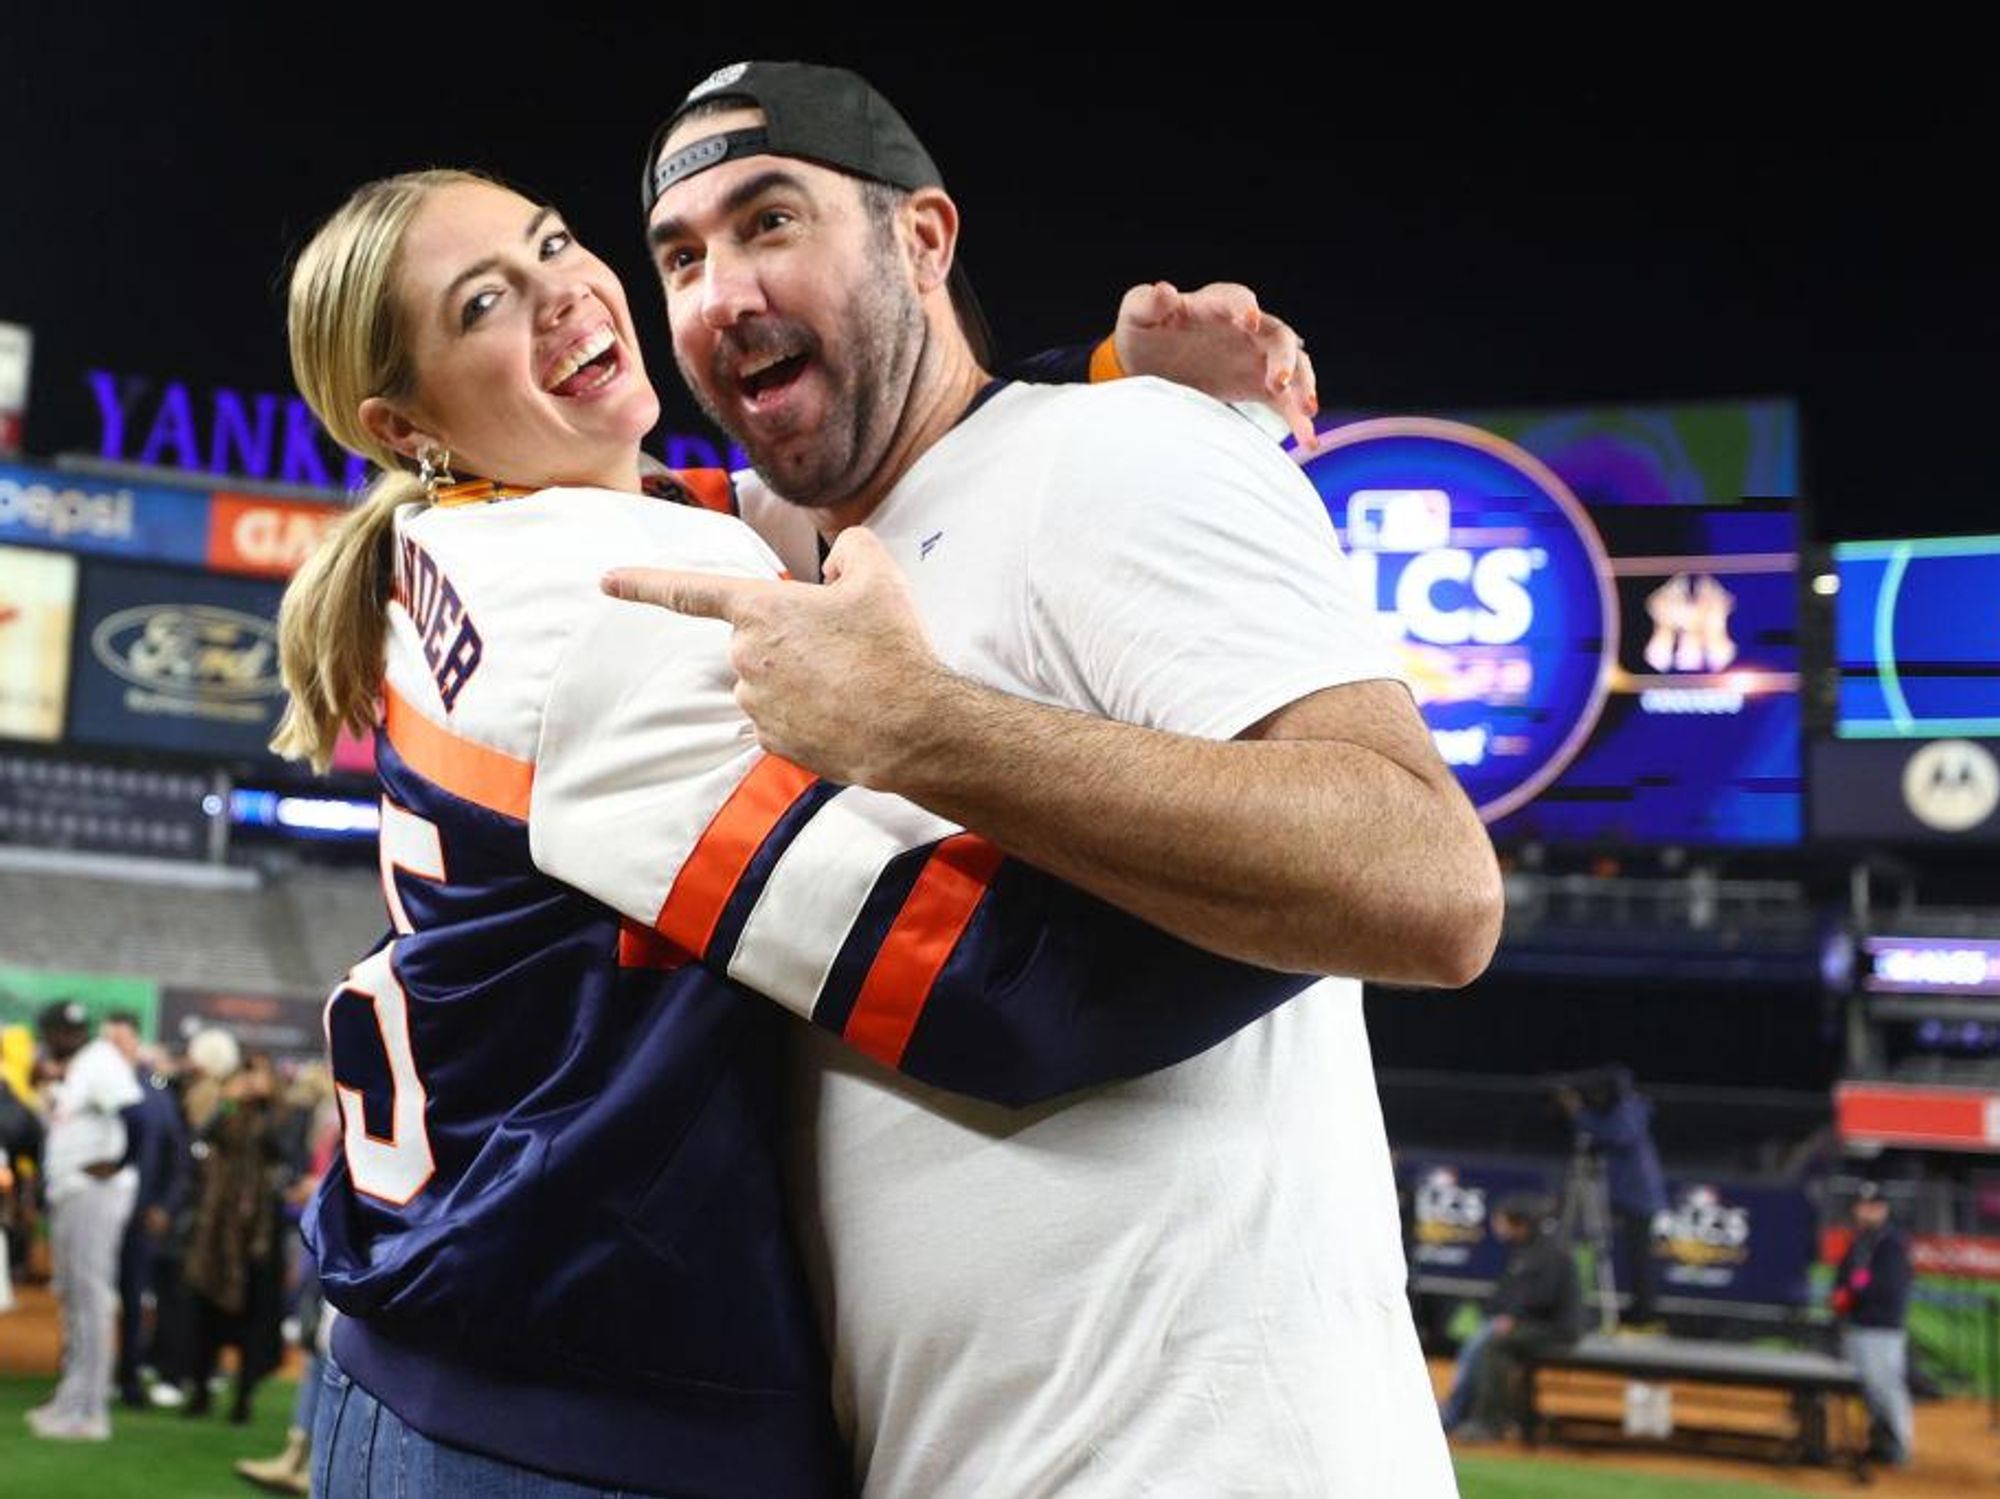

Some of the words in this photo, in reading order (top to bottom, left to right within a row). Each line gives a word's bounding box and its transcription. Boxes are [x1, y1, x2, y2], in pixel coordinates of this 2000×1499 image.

[87, 370, 368, 494] YANK
[231, 507, 325, 566] GA
[401, 531, 484, 714] NDER
[1345, 546, 1535, 645] LCS
